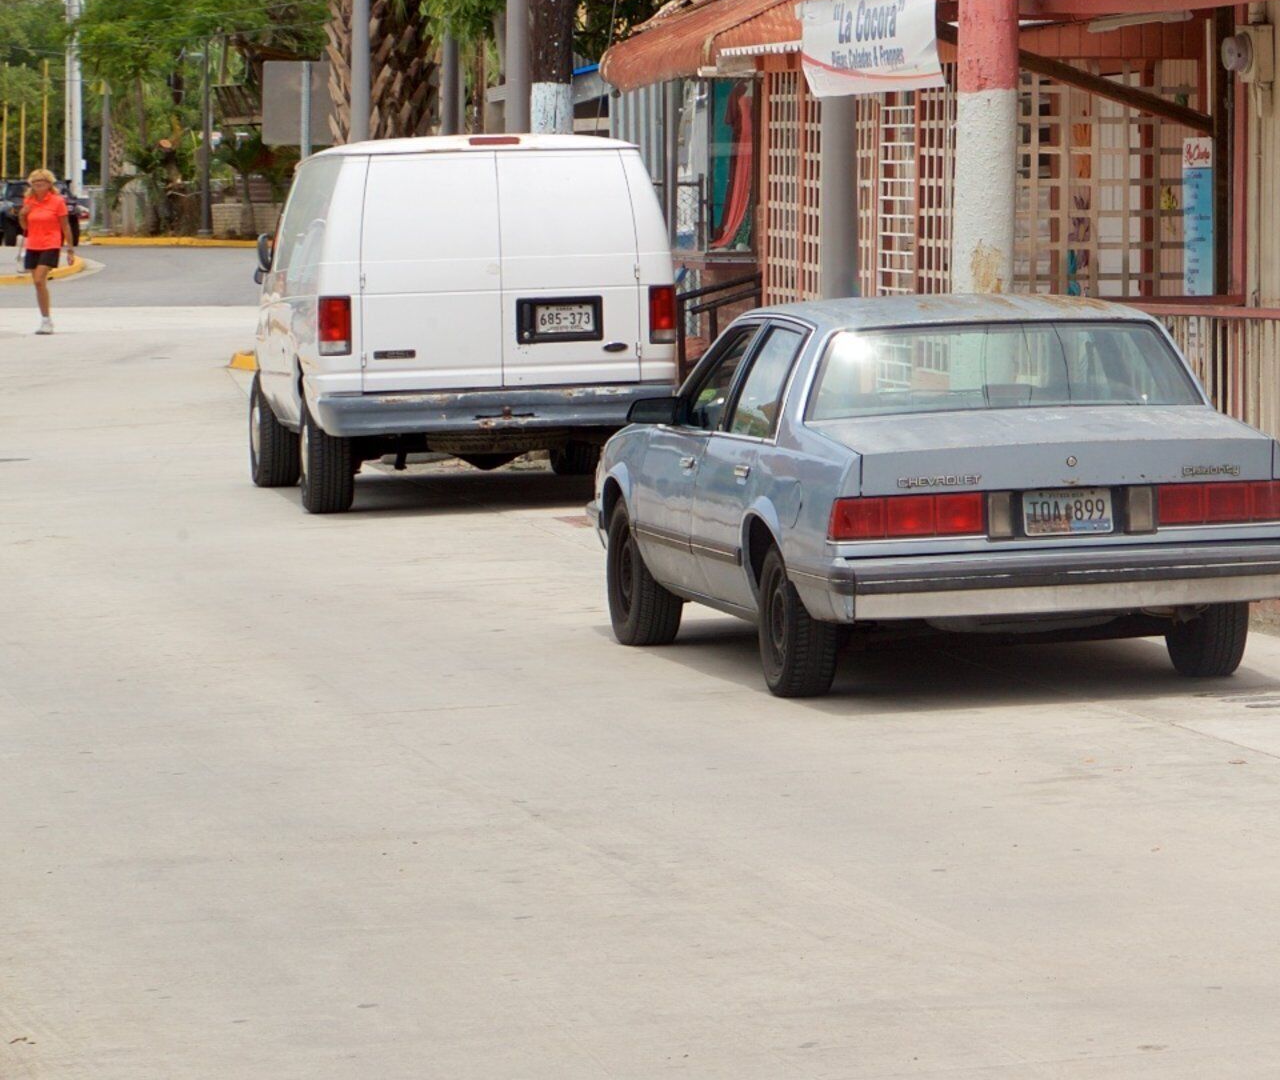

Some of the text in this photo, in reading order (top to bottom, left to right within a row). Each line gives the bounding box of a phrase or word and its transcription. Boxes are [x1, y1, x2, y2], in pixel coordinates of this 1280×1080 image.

[539, 312, 591, 326] 685-373
[897, 473, 981, 489] CHEVROLET
[1073, 498, 1105, 520] 899
